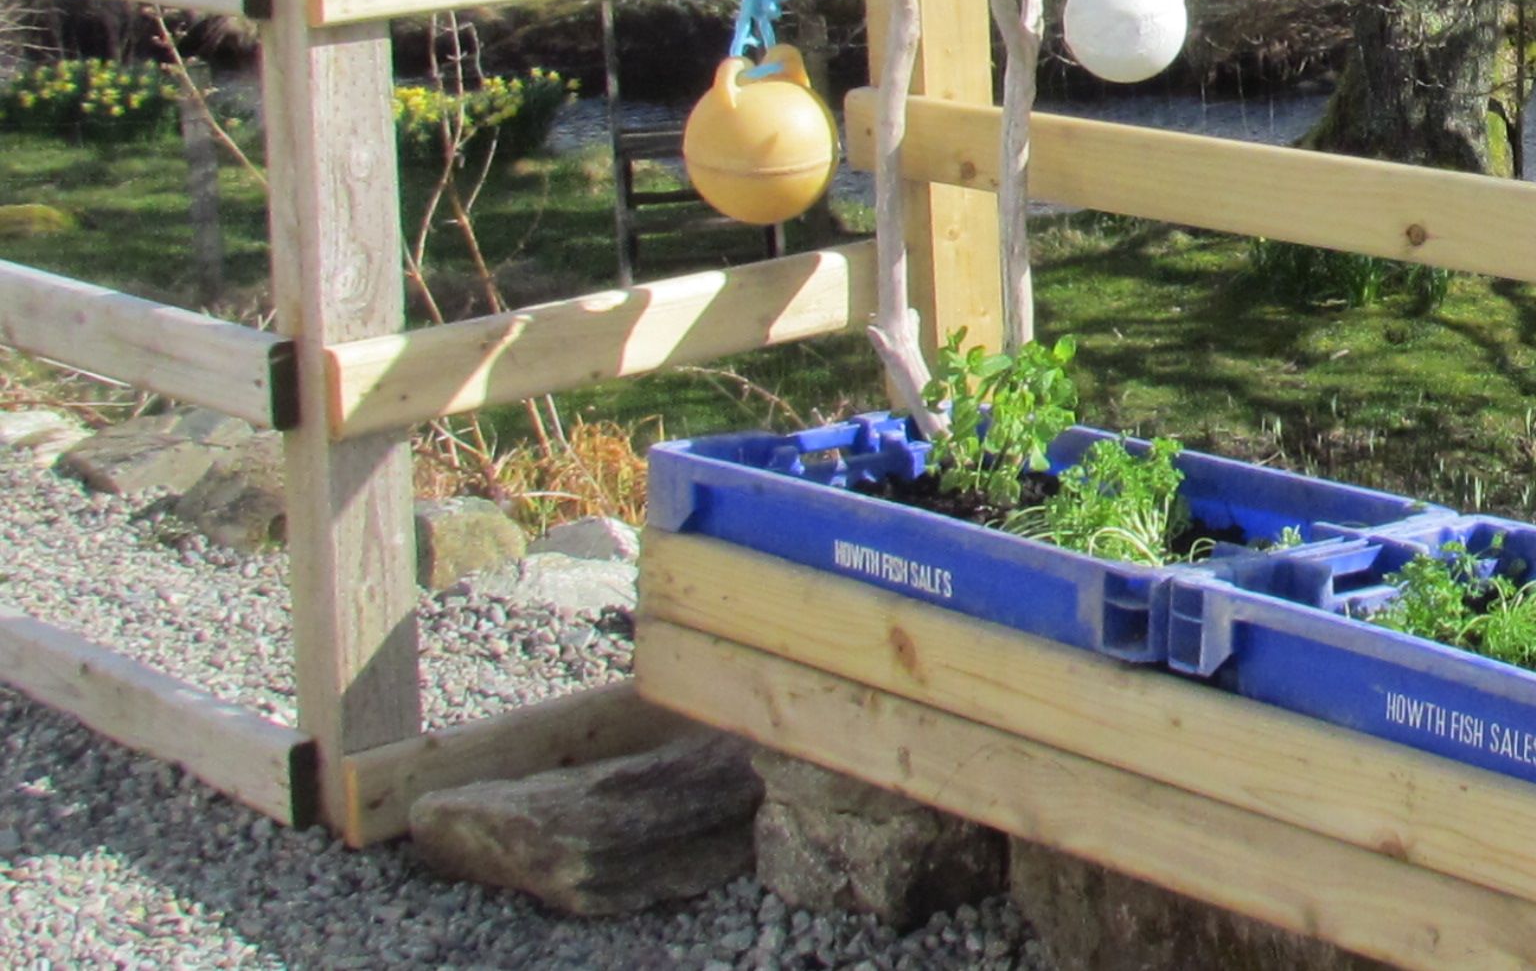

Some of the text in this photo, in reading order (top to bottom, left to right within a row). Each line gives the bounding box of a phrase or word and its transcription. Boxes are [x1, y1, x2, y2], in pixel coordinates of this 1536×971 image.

[834, 539, 953, 598] HOWTH FISH SALES
[1386, 692, 1446, 736] HOWTH
[1451, 711, 1484, 748] FISH
